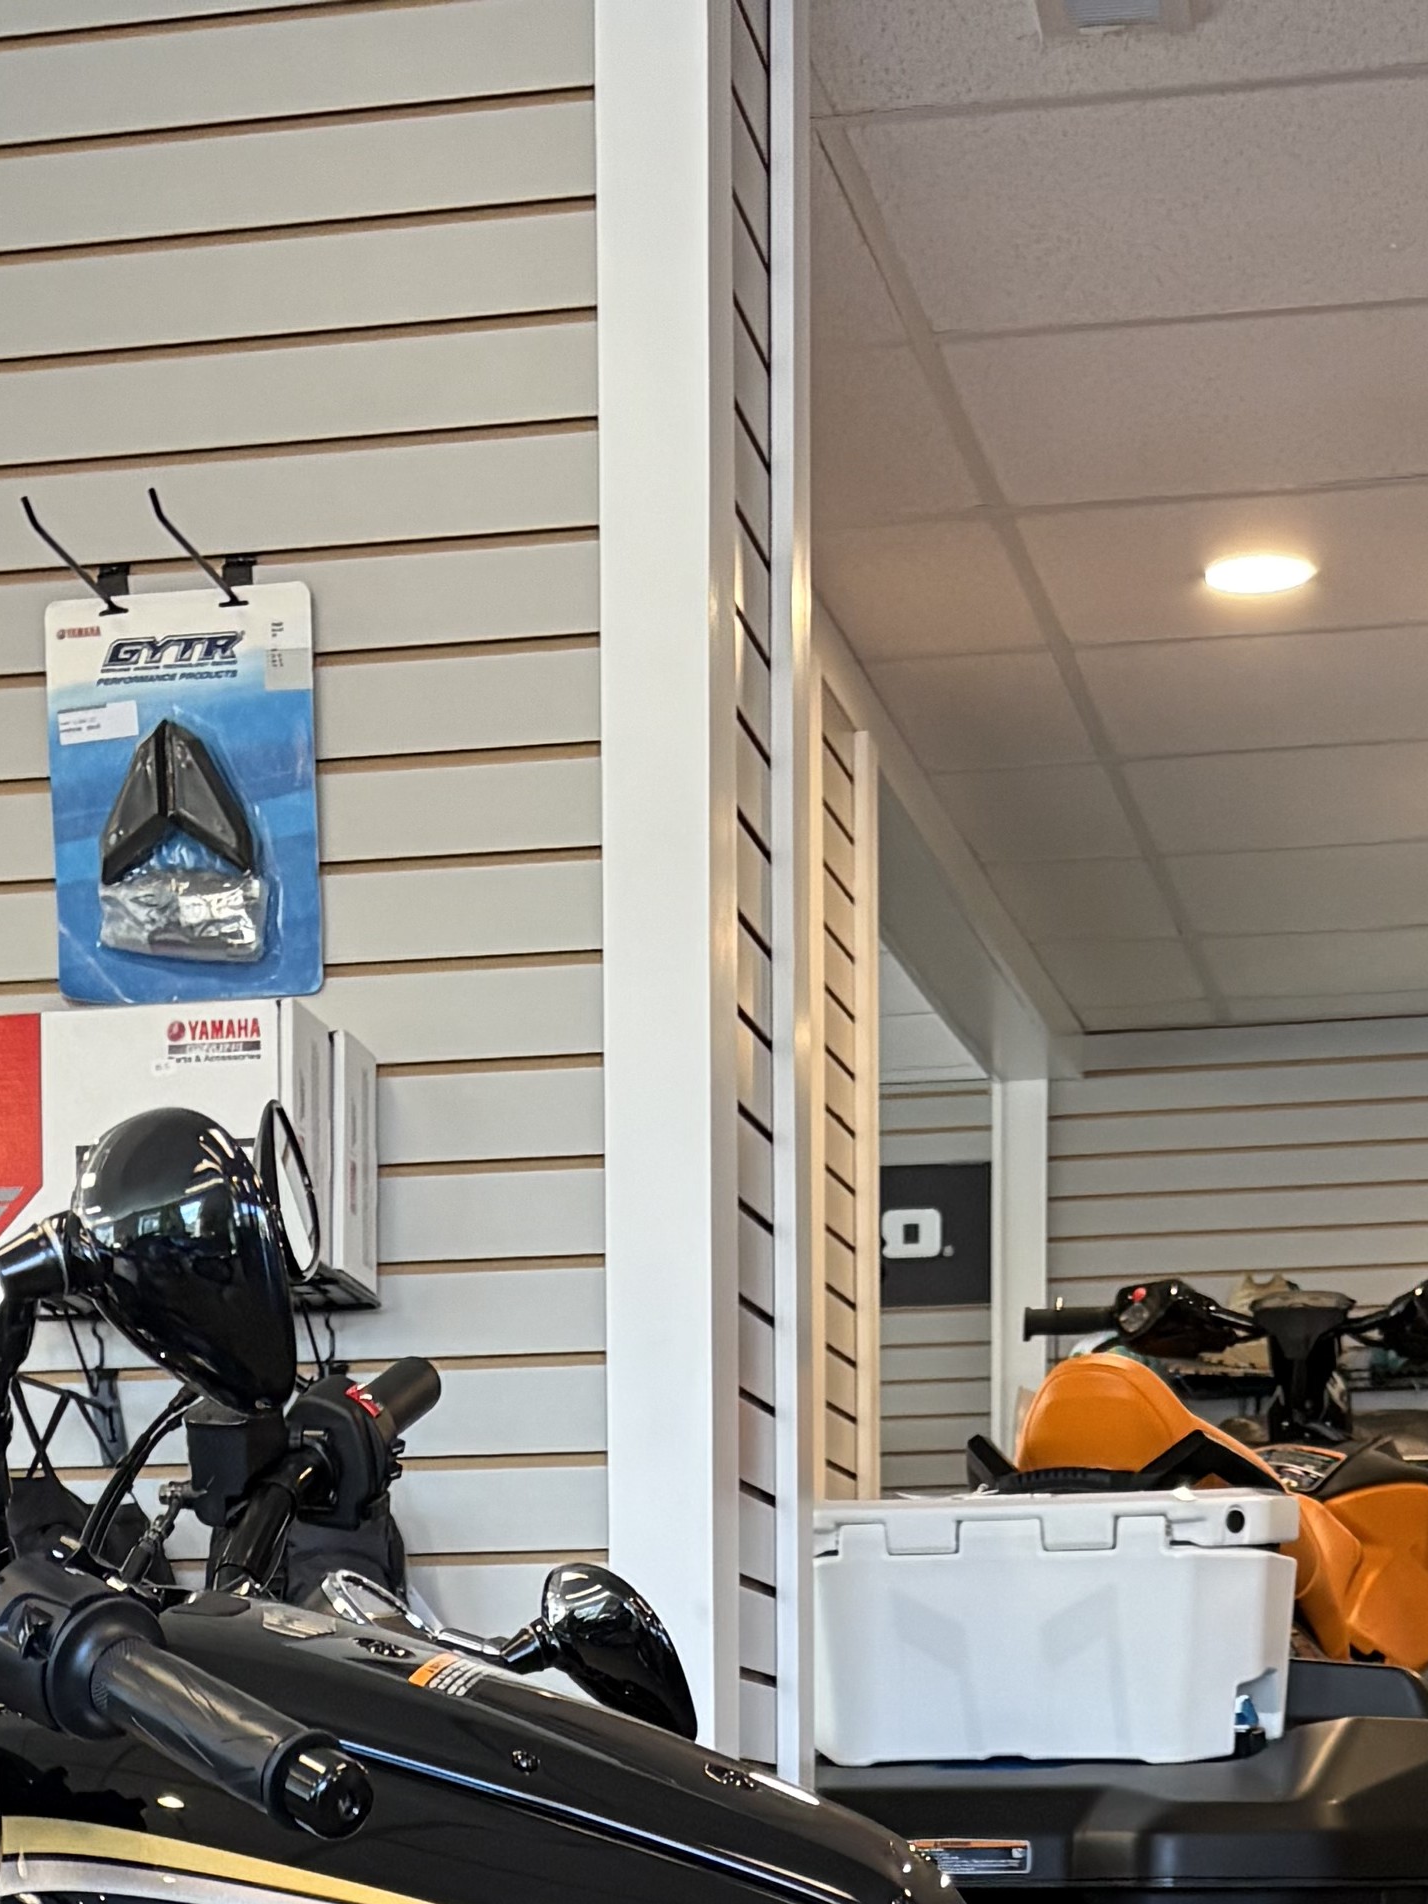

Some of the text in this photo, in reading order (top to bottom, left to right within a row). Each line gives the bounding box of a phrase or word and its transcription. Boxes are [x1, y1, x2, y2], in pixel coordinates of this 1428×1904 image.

[102, 631, 240, 667] GYTR
[96, 669, 238, 687] PERFORMANCE PRODUCTS
[188, 1018, 261, 1041] YAMAHA
